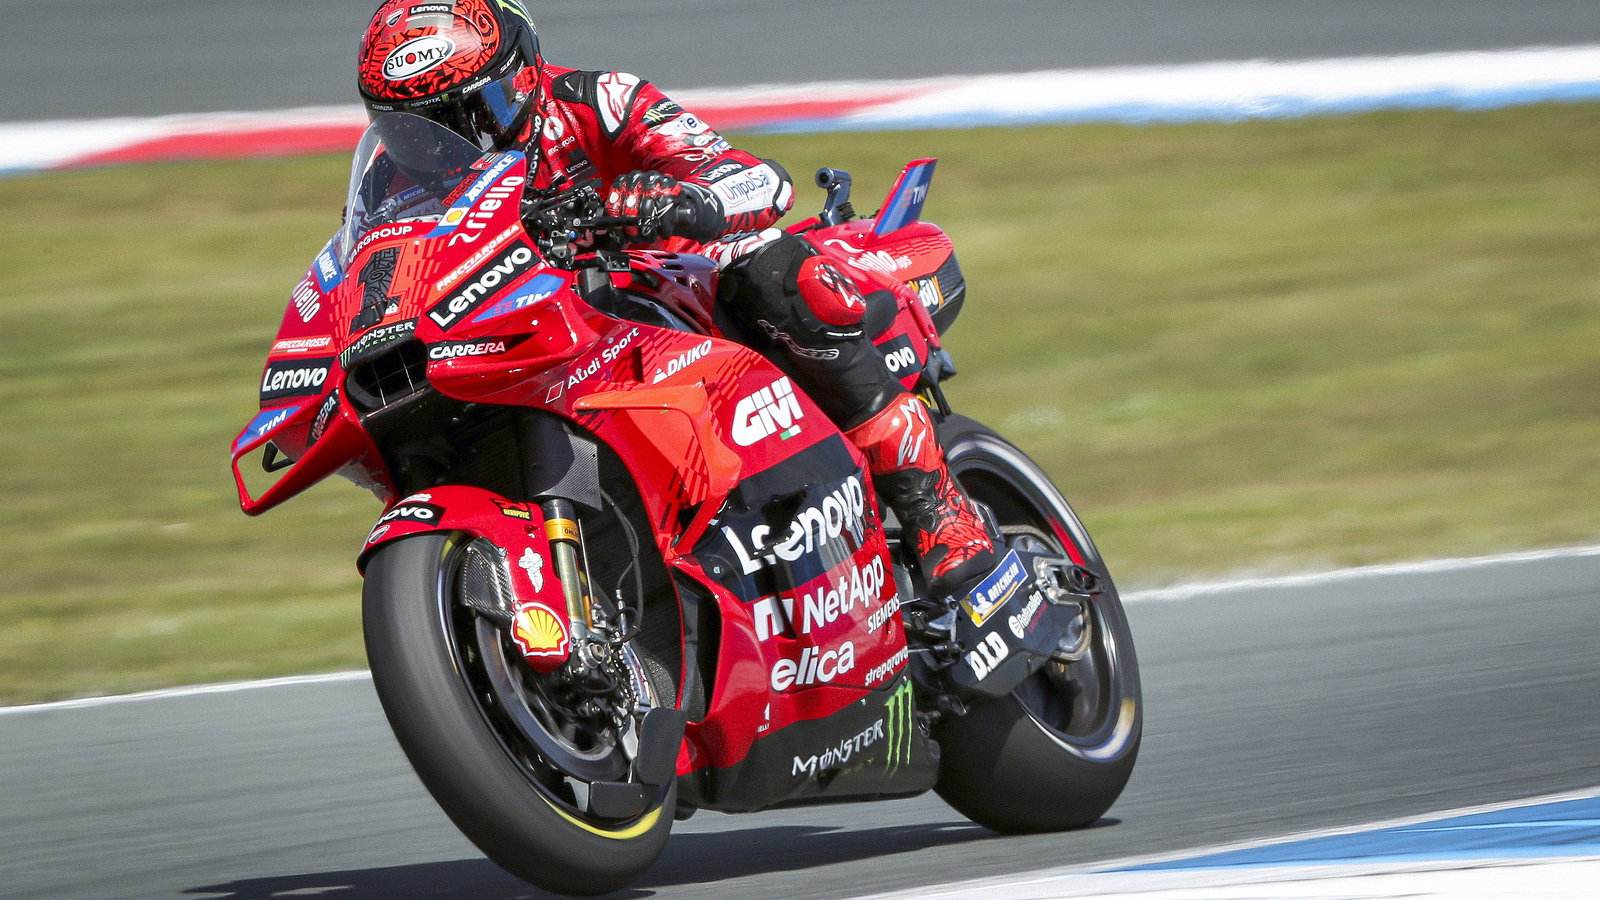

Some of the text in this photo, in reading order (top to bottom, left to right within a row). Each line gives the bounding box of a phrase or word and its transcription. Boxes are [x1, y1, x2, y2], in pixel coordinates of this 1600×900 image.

[410, 6, 450, 14] Lenovo
[386, 46, 446, 72] SUOMY
[464, 153, 518, 203] ADVANCE
[565, 159, 588, 174] Lenovo
[465, 175, 525, 230] riello
[436, 224, 521, 292] FRECCIAROSSA
[429, 246, 532, 328] Lenovo
[272, 336, 331, 350] FRECCIAROSSA
[351, 321, 416, 354] MONSTER
[358, 332, 405, 354] ENERGY
[429, 341, 506, 360] CARRERA
[566, 326, 641, 390] Audi Sport
[667, 339, 712, 377] DAIKO
[884, 346, 917, 374] ovo
[261, 366, 328, 393] Lenovo
[258, 409, 287, 437] TIM
[731, 375, 805, 447] GIVI
[802, 554, 885, 635] NetApp
[867, 592, 901, 635] SIEMENS
[770, 640, 855, 692] elica
[864, 645, 910, 687] streparava
[791, 718, 885, 778] MONSTER
